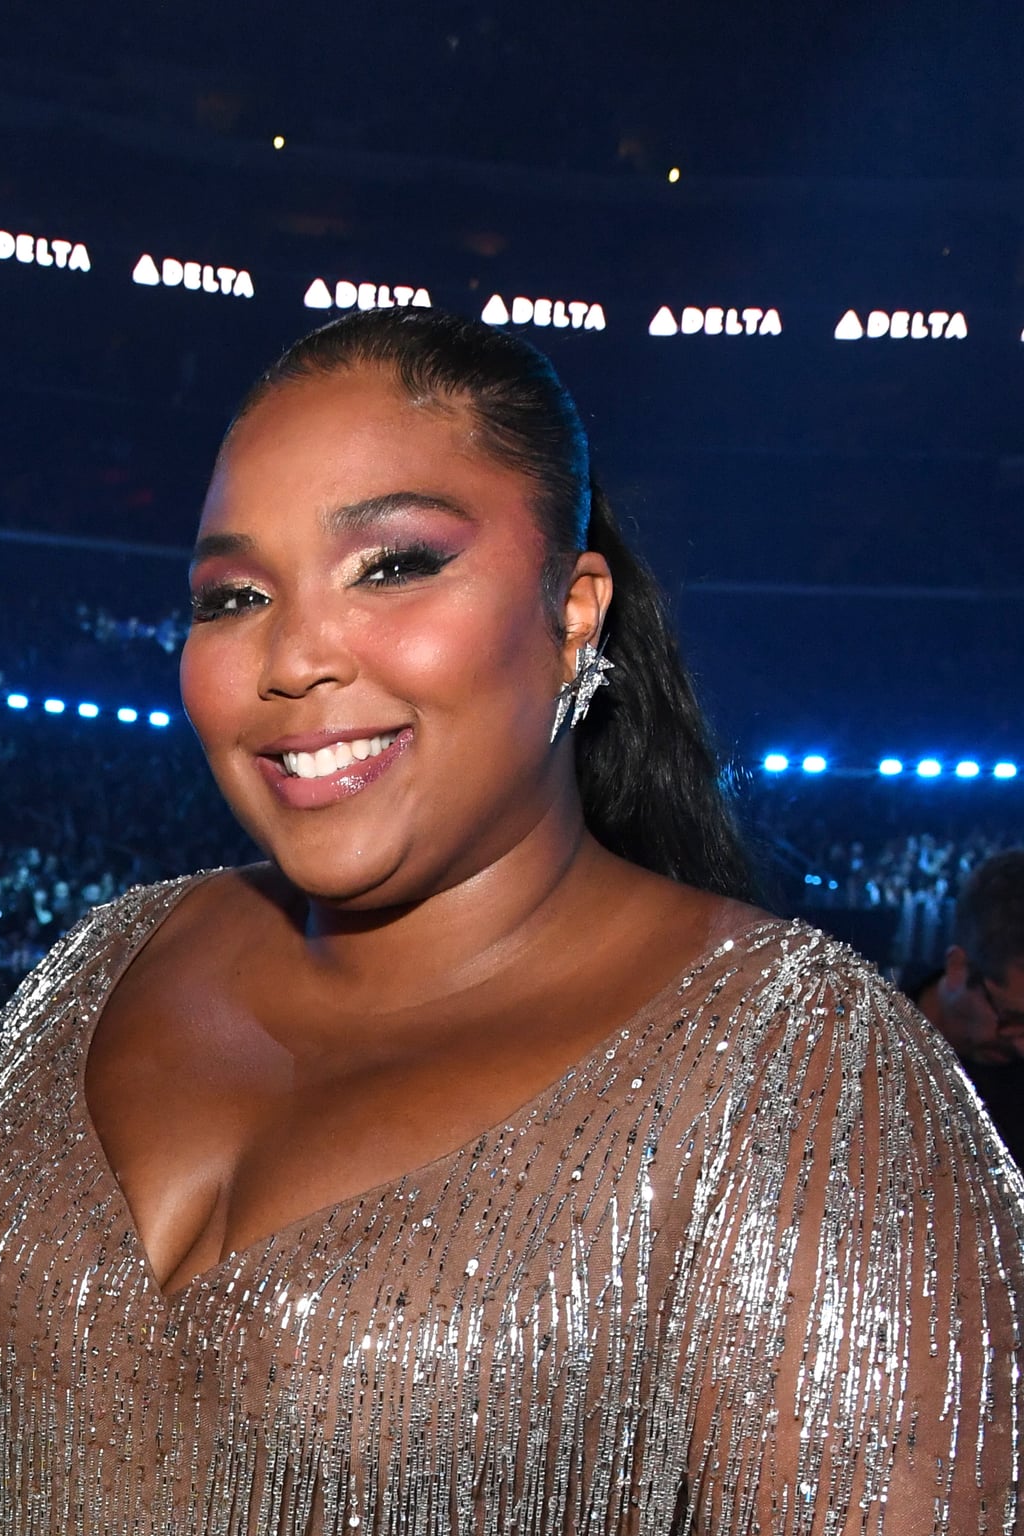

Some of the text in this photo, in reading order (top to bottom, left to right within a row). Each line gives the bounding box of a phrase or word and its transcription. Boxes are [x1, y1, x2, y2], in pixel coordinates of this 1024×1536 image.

[161, 258, 255, 299] DELTA
[335, 280, 432, 313] DELTA
[511, 296, 606, 331] DELTA
[680, 306, 782, 336] DELTA
[866, 310, 968, 340] DELTA
